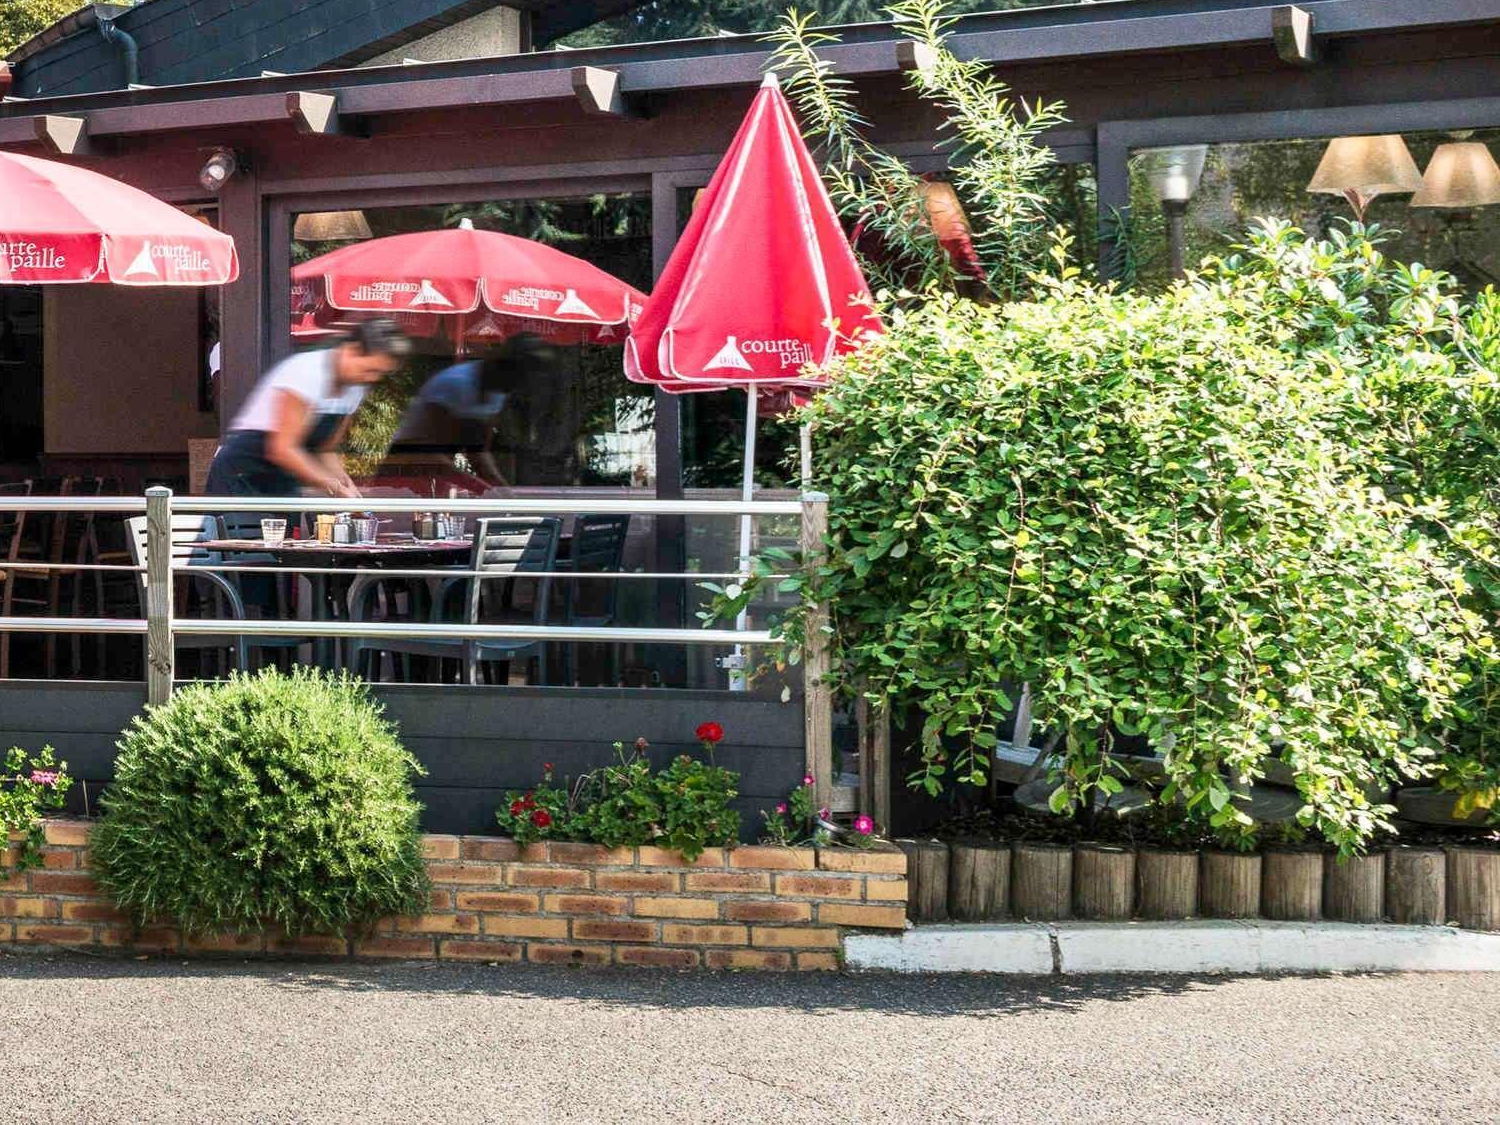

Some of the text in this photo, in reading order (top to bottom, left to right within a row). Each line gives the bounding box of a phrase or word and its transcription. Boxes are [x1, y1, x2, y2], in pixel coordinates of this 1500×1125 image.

[10, 248, 66, 272] paille
[152, 245, 190, 259] courte
[174, 251, 211, 275] paille
[741, 339, 800, 353] courte
[780, 343, 813, 369] paill
